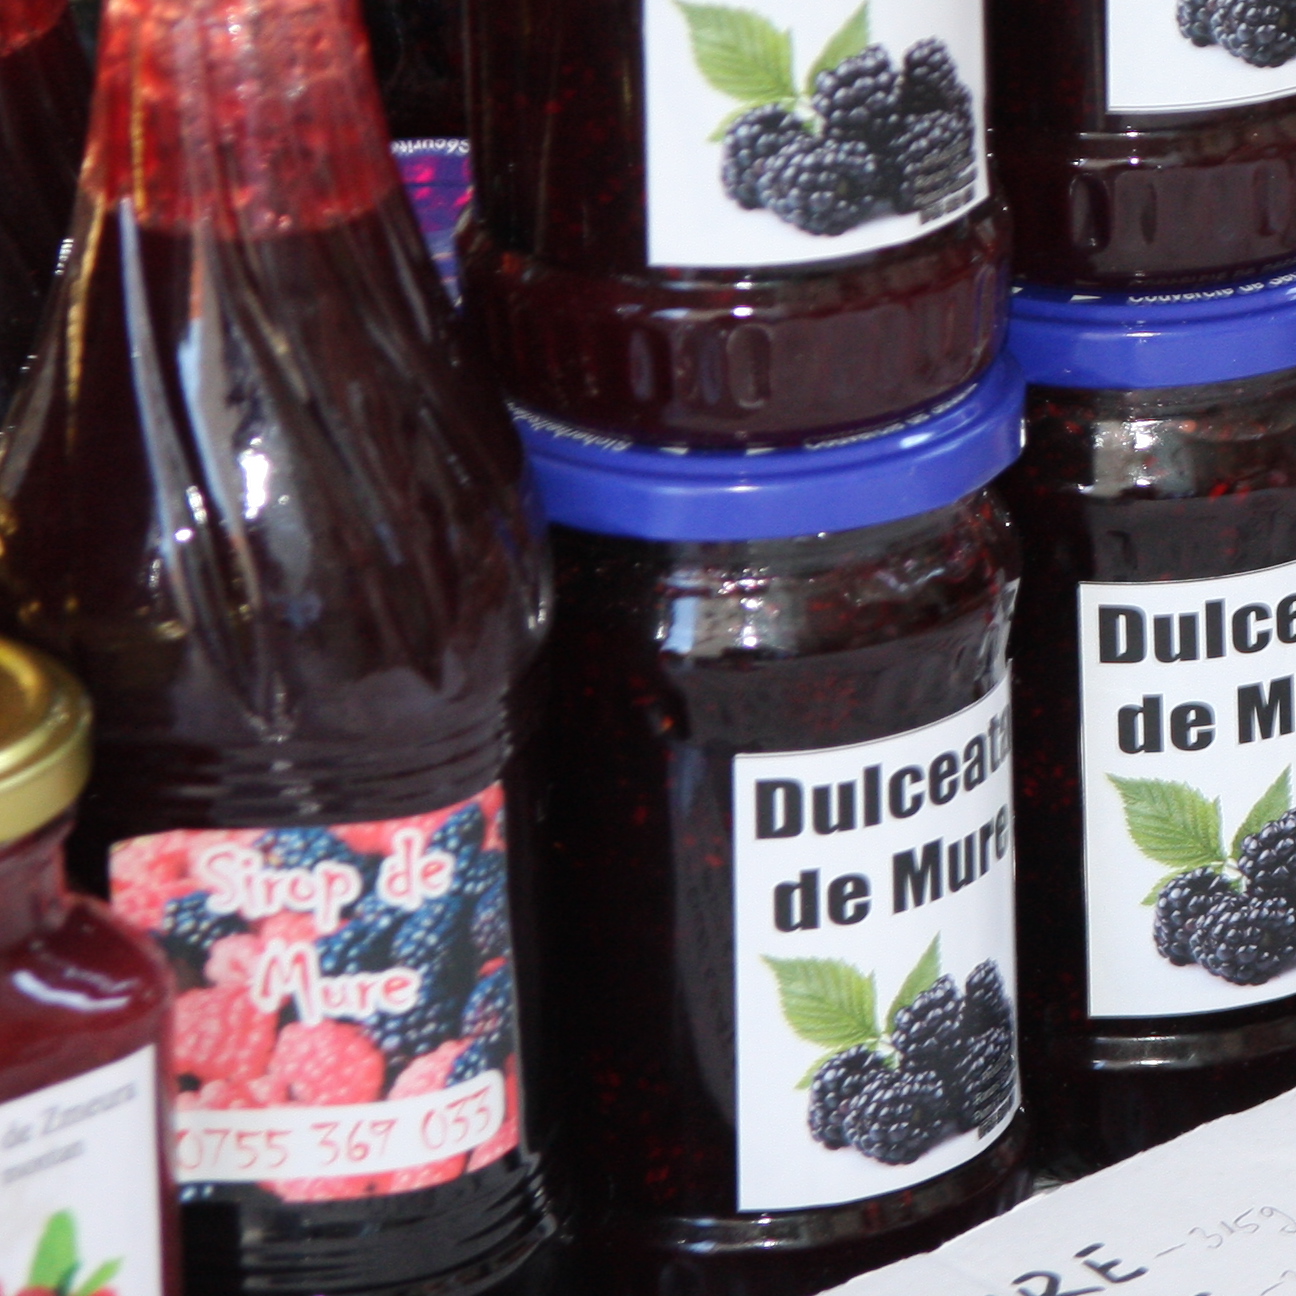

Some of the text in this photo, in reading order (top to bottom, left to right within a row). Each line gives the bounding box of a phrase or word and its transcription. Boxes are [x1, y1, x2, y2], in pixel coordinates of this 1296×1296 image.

[1116, 694, 1217, 754] de
[754, 704, 1011, 840] Dulceata
[200, 829, 454, 931] Sirop de
[772, 803, 1009, 933] de Mure
[250, 938, 420, 1024] Mure
[175, 1126, 293, 1171] 0755
[419, 1085, 491, 1150] 033
